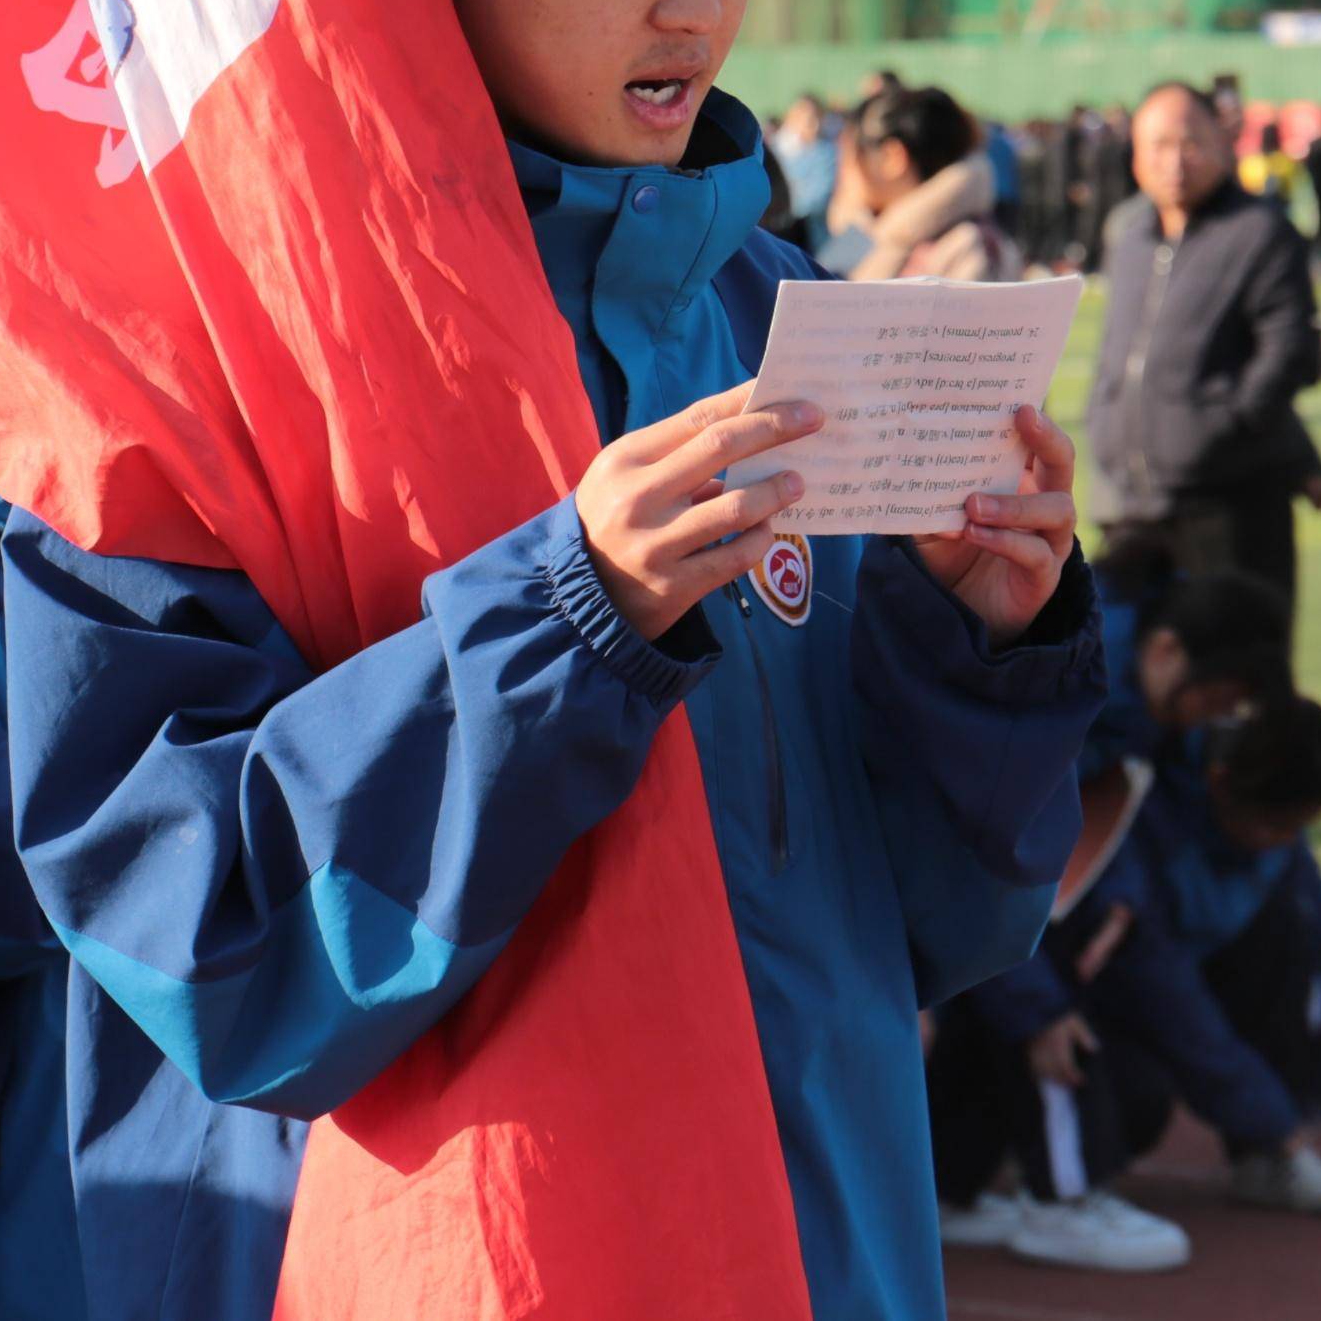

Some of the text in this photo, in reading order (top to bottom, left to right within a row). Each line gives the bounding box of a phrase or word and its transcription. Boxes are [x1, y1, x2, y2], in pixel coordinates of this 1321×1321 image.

[987, 328, 1024, 338] promise
[978, 352, 1017, 363] progress
[978, 380, 1009, 390] abroad
[951, 402, 1001, 413] production
[978, 430, 994, 440] aim
[970, 455, 986, 463] tear
[956, 479, 976, 489] strict
[936, 504, 963, 514] mazing
